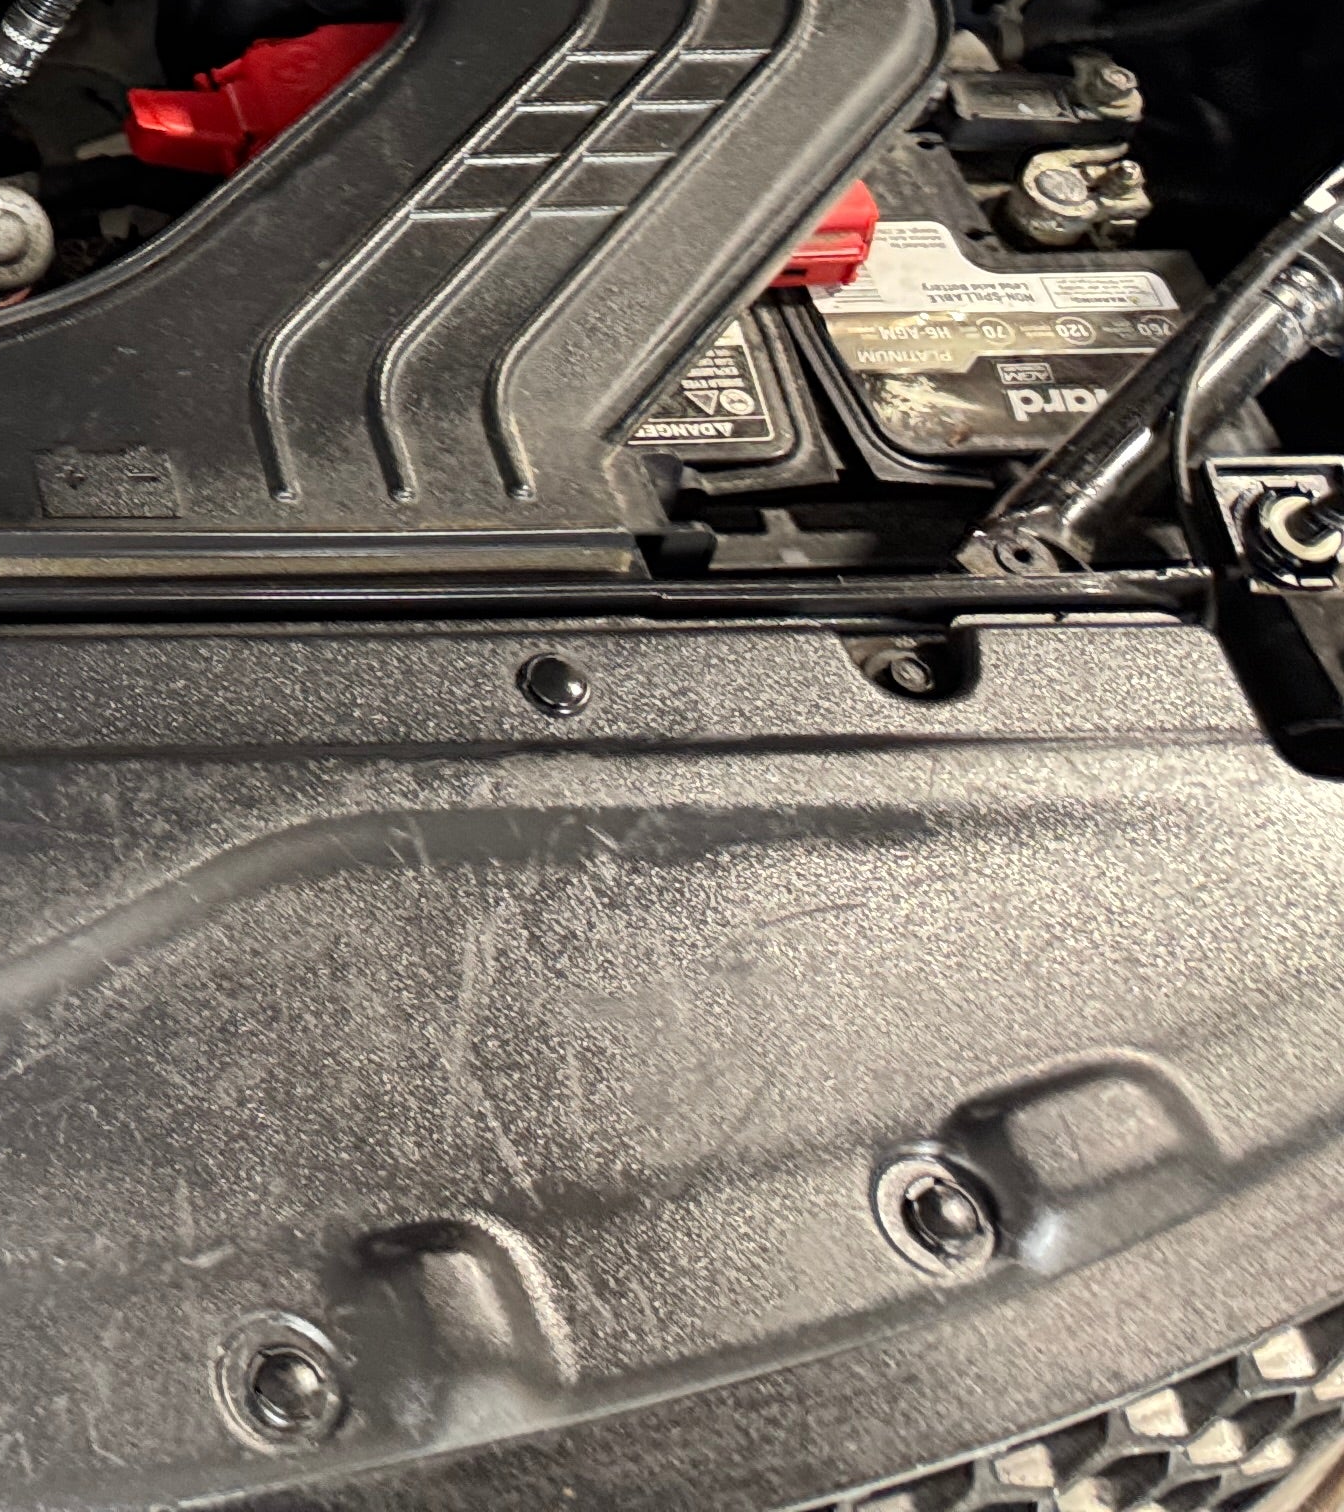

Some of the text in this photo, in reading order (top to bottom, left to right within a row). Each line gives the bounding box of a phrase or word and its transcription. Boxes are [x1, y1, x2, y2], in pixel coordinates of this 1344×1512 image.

[925, 291, 1035, 304] NON-SPILLABLE
[878, 324, 952, 340] H6-AGM
[981, 324, 1005, 339] 70
[1055, 323, 1090, 339] 120
[856, 348, 953, 364] PLATINUM
[1002, 370, 1051, 382] AGM
